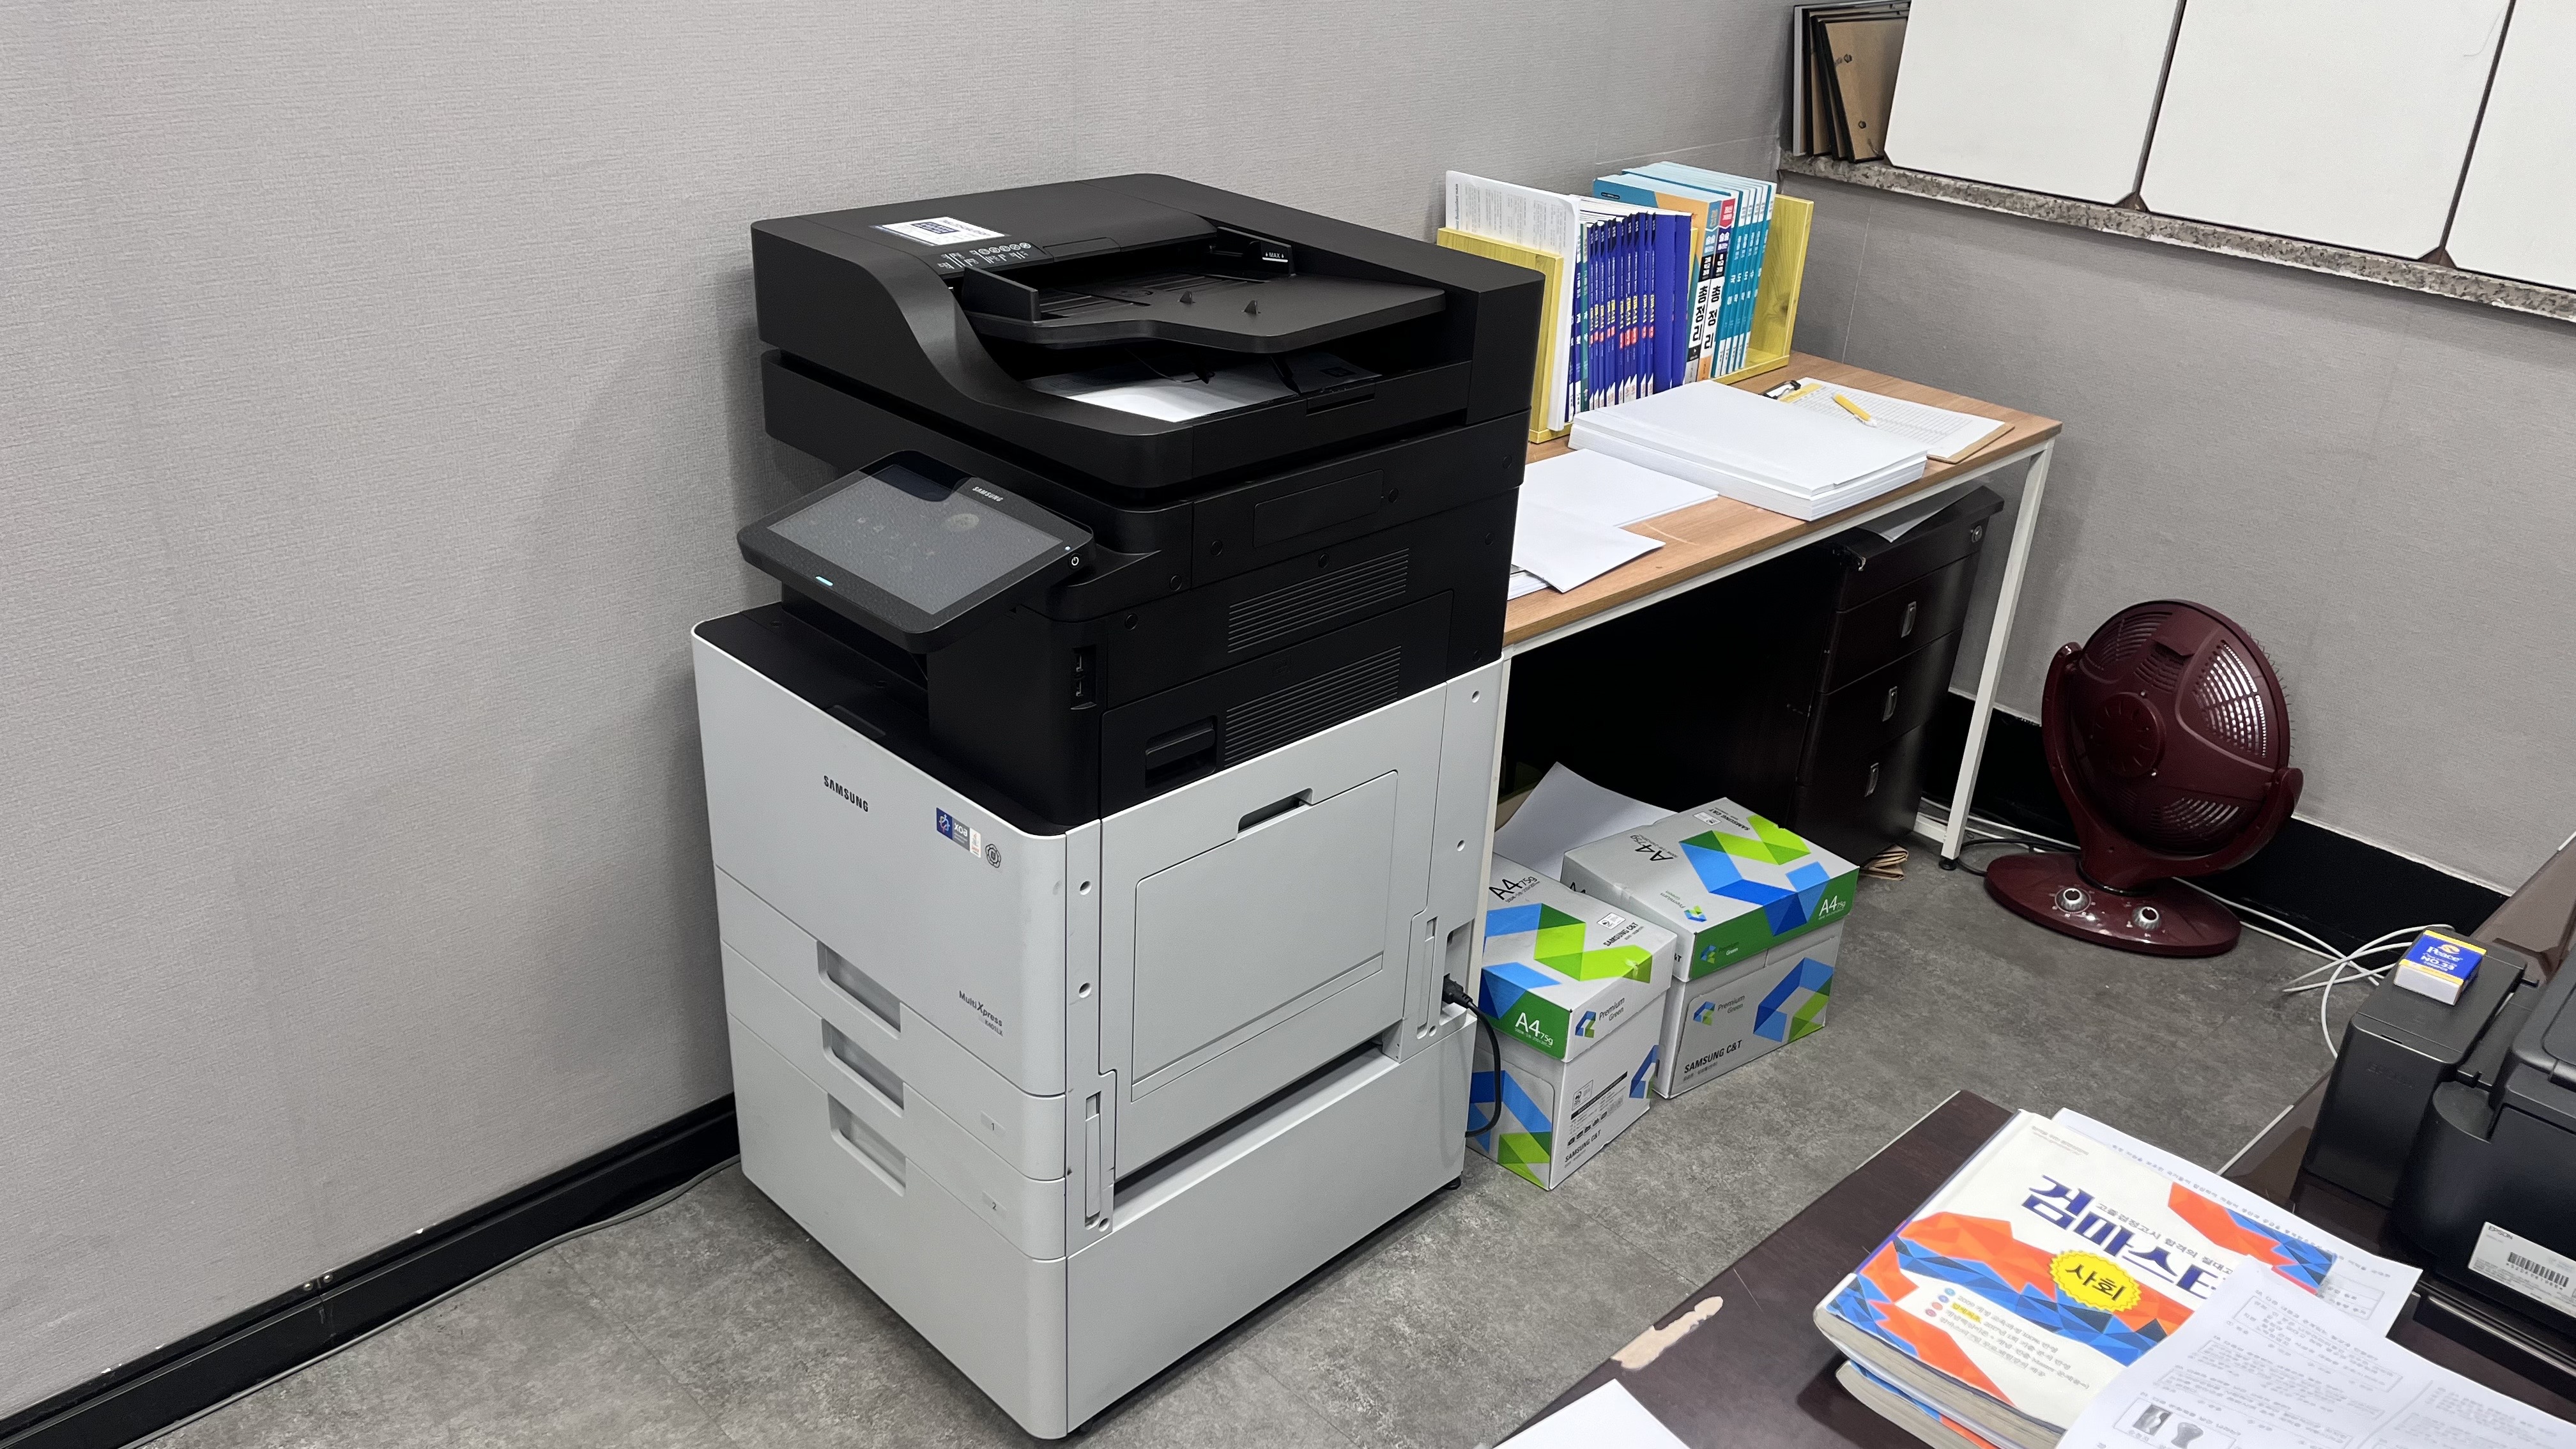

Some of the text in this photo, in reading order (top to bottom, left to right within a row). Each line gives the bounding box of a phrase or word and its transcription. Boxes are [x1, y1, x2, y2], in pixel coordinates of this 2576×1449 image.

[1692, 286, 1708, 341] 총정리
[1704, 286, 1721, 349] 총정리
[972, 486, 1004, 502] SAMSUNG
[824, 775, 869, 813] SAMSUNG
[1721, 814, 1751, 831] SAMSUNG
[1635, 843, 1674, 861] A4
[1489, 878, 1522, 900] A4
[1819, 895, 1837, 917] A4
[1604, 929, 1629, 946] SAMSUNG
[1726, 947, 1738, 956] Green
[959, 990, 1002, 1027] MultiXpress
[1598, 998, 1625, 1020] Premium
[1609, 1007, 1624, 1021] Green
[1717, 995, 1745, 1011] Premium
[1728, 1004, 1744, 1014] Green
[1515, 1012, 1540, 1037] A4
[1540, 1032, 1553, 1046] 75g
[1684, 1048, 1725, 1074] SAMSUNG
[1726, 1039, 1743, 1054] C&T
[991, 1123, 995, 1131] 1
[1565, 1138, 1590, 1162] SAMSUNG
[992, 1202, 997, 1211] 2
[2096, 1202, 2162, 1239] 고졸검정고시
[2165, 1237, 2198, 1258] 합격의
[2488, 1225, 2513, 1240] EPSON
[2065, 1264, 2126, 1301] 사회
